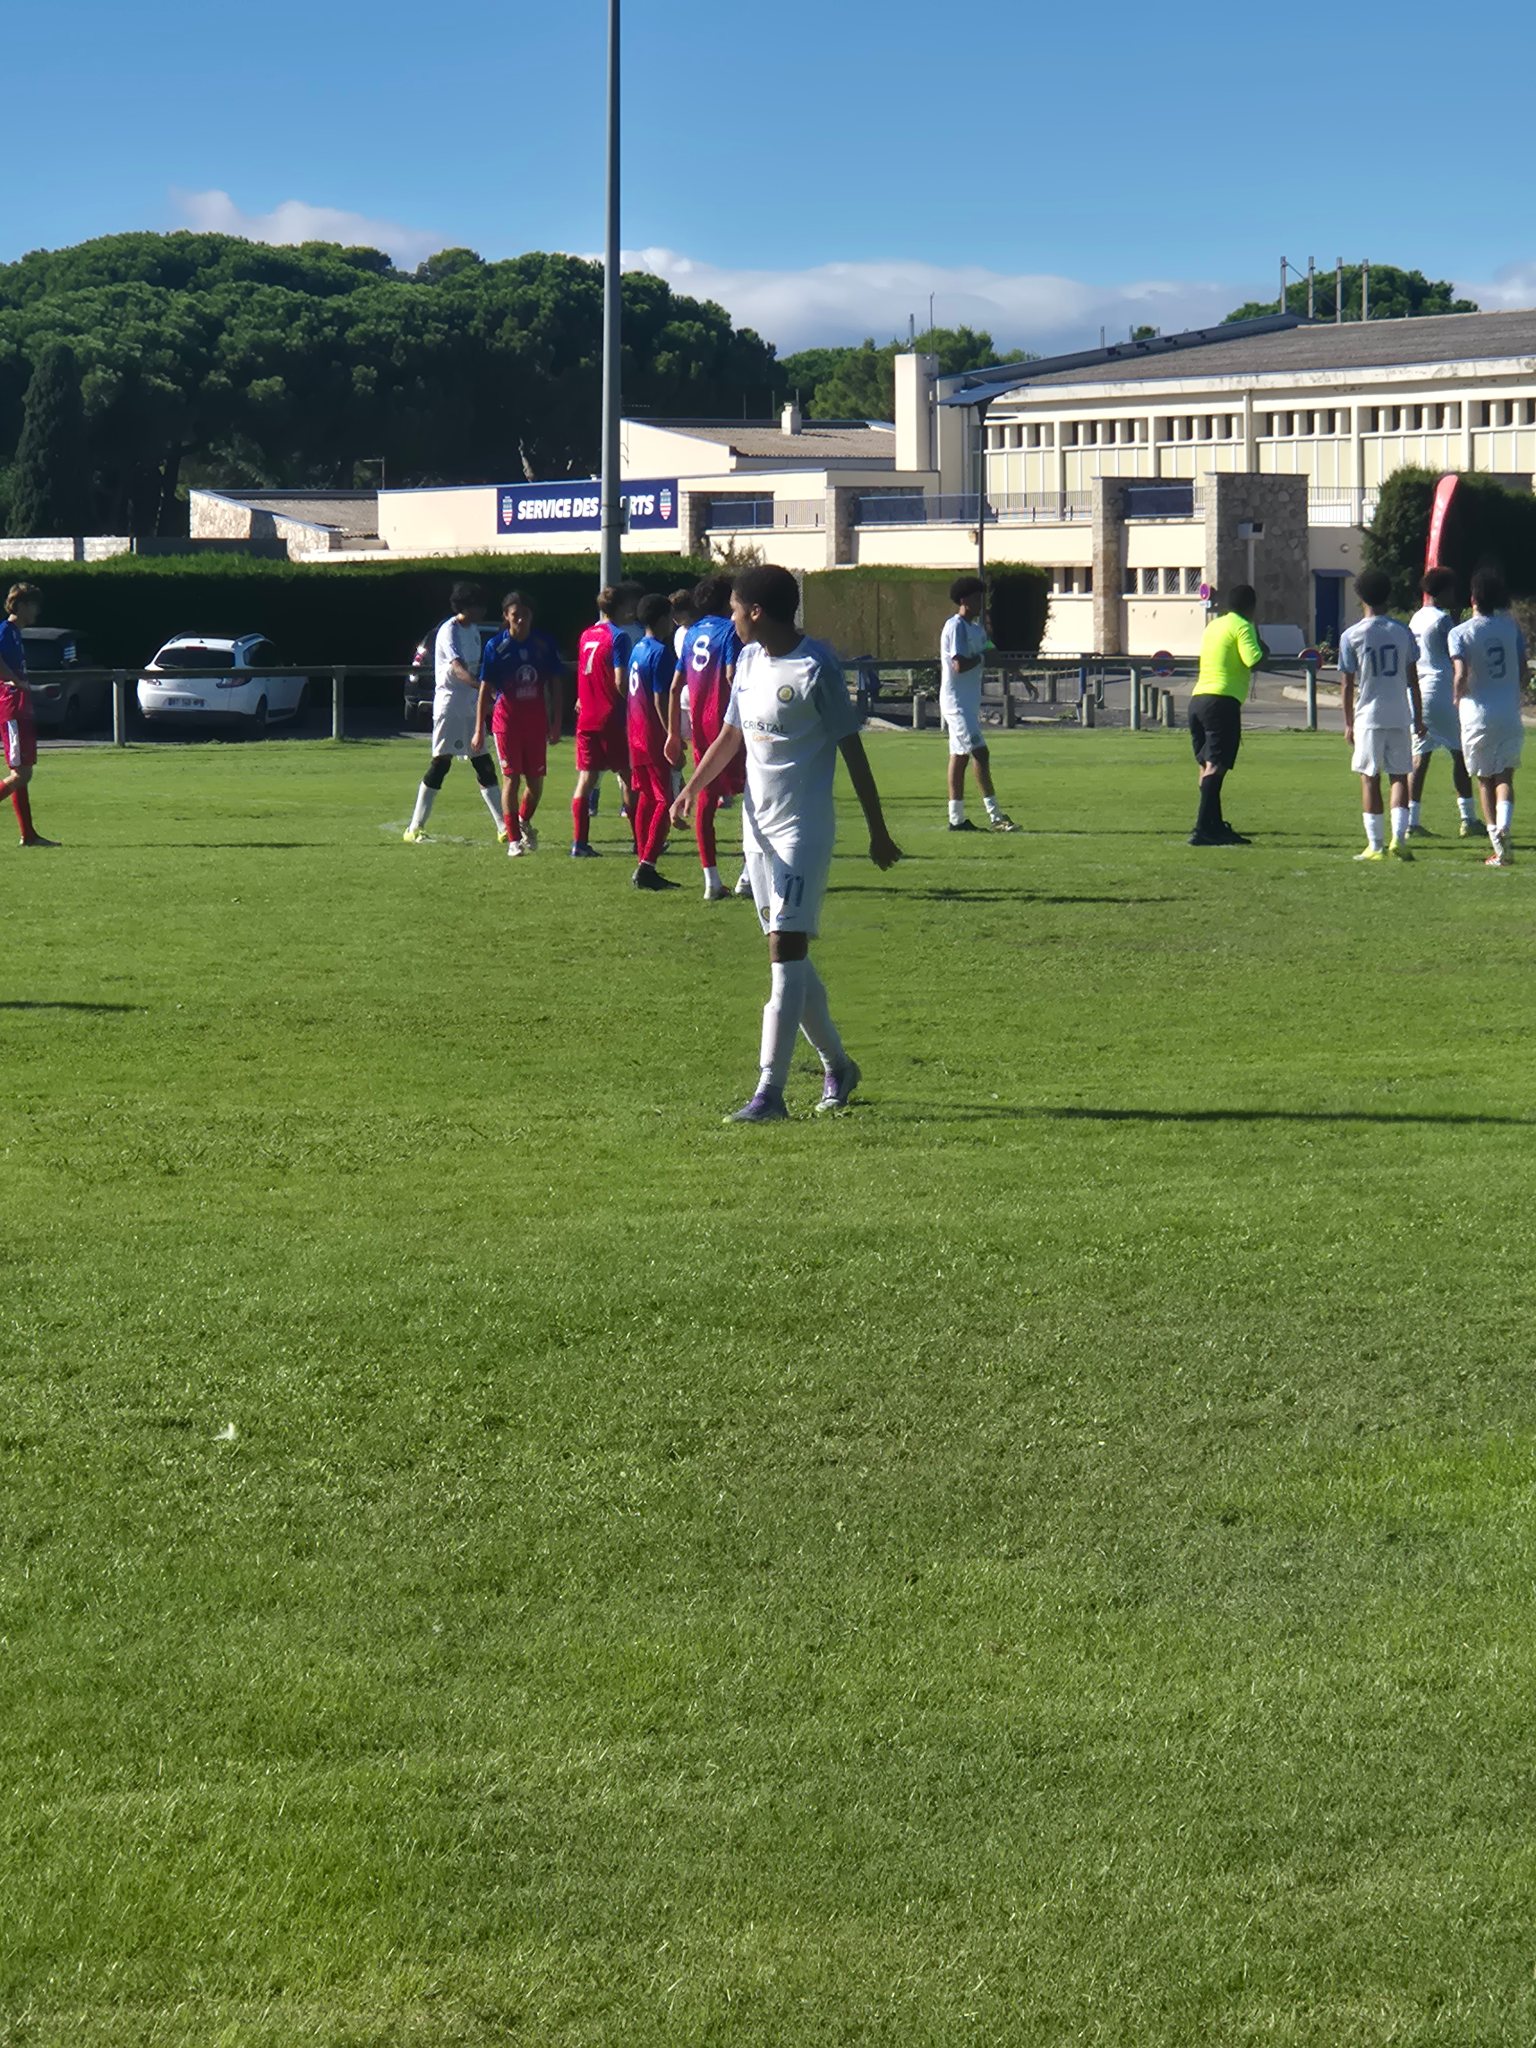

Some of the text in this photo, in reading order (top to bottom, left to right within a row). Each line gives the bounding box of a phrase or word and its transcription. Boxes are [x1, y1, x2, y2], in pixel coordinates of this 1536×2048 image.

[517, 499, 571, 520] SERVICE
[572, 497, 599, 518] DES
[583, 641, 599, 675] 7
[692, 635, 710, 672] 8
[1366, 644, 1399, 677] 10
[1487, 646, 1506, 679] 3
[628, 661, 640, 696] 6
[743, 720, 787, 734] CRISTAL
[784, 873, 805, 907] 11
